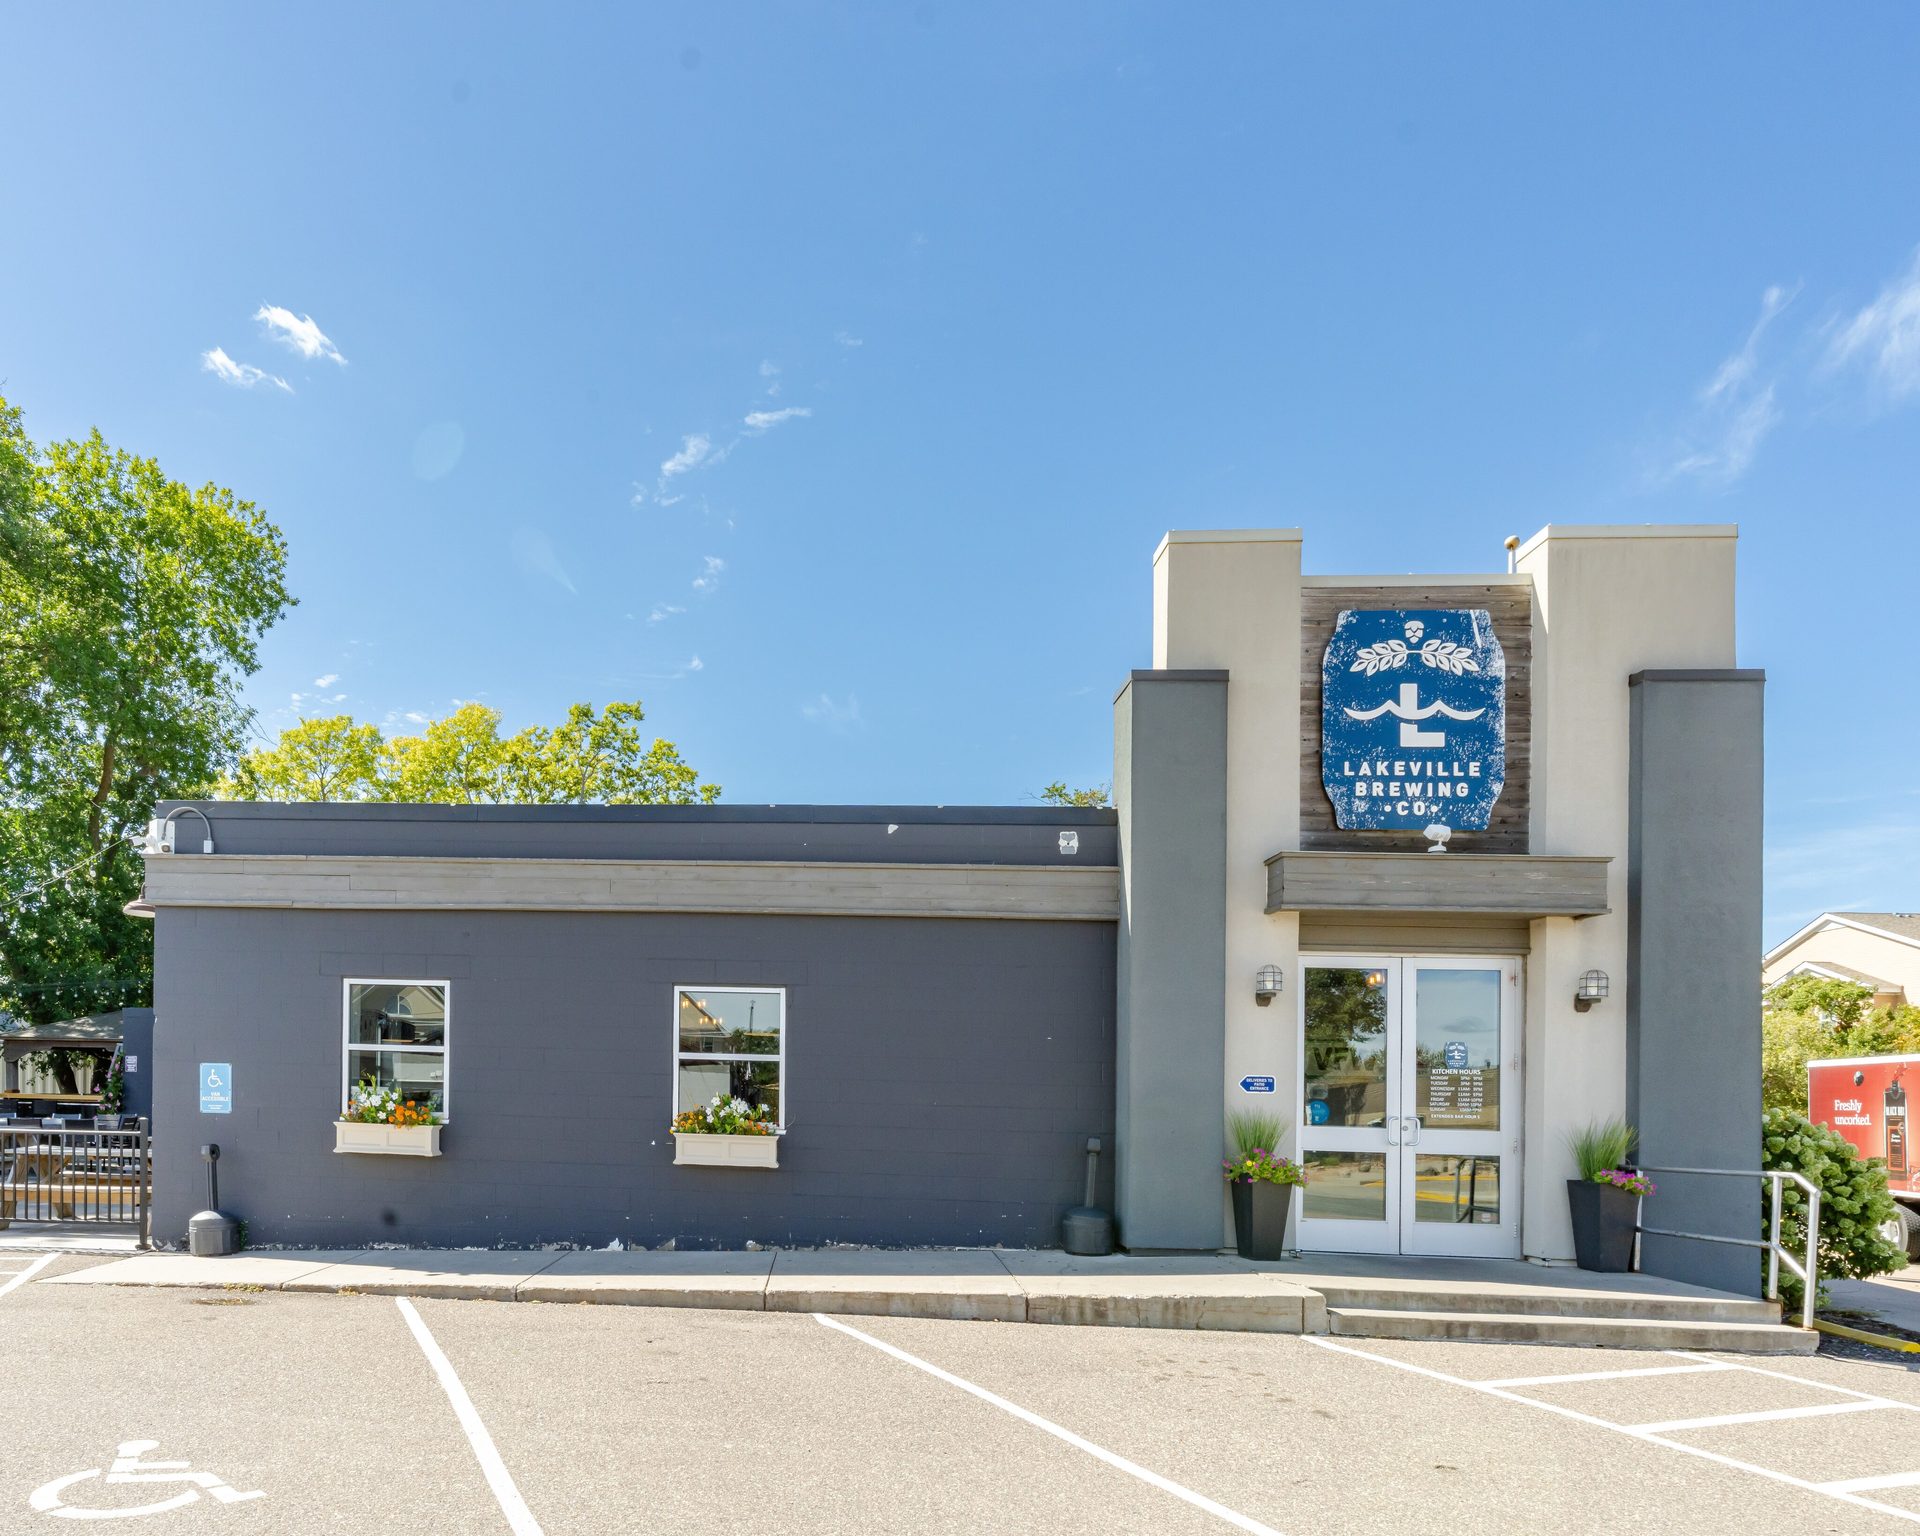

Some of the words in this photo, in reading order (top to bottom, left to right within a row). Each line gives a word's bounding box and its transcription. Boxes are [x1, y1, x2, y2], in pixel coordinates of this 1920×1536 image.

[1343, 761, 1481, 777] LAKEVILLE
[1355, 782, 1469, 797] BREWING
[1834, 1099, 1862, 1112] Freshly
[1834, 1114, 1872, 1126] uncorked.
